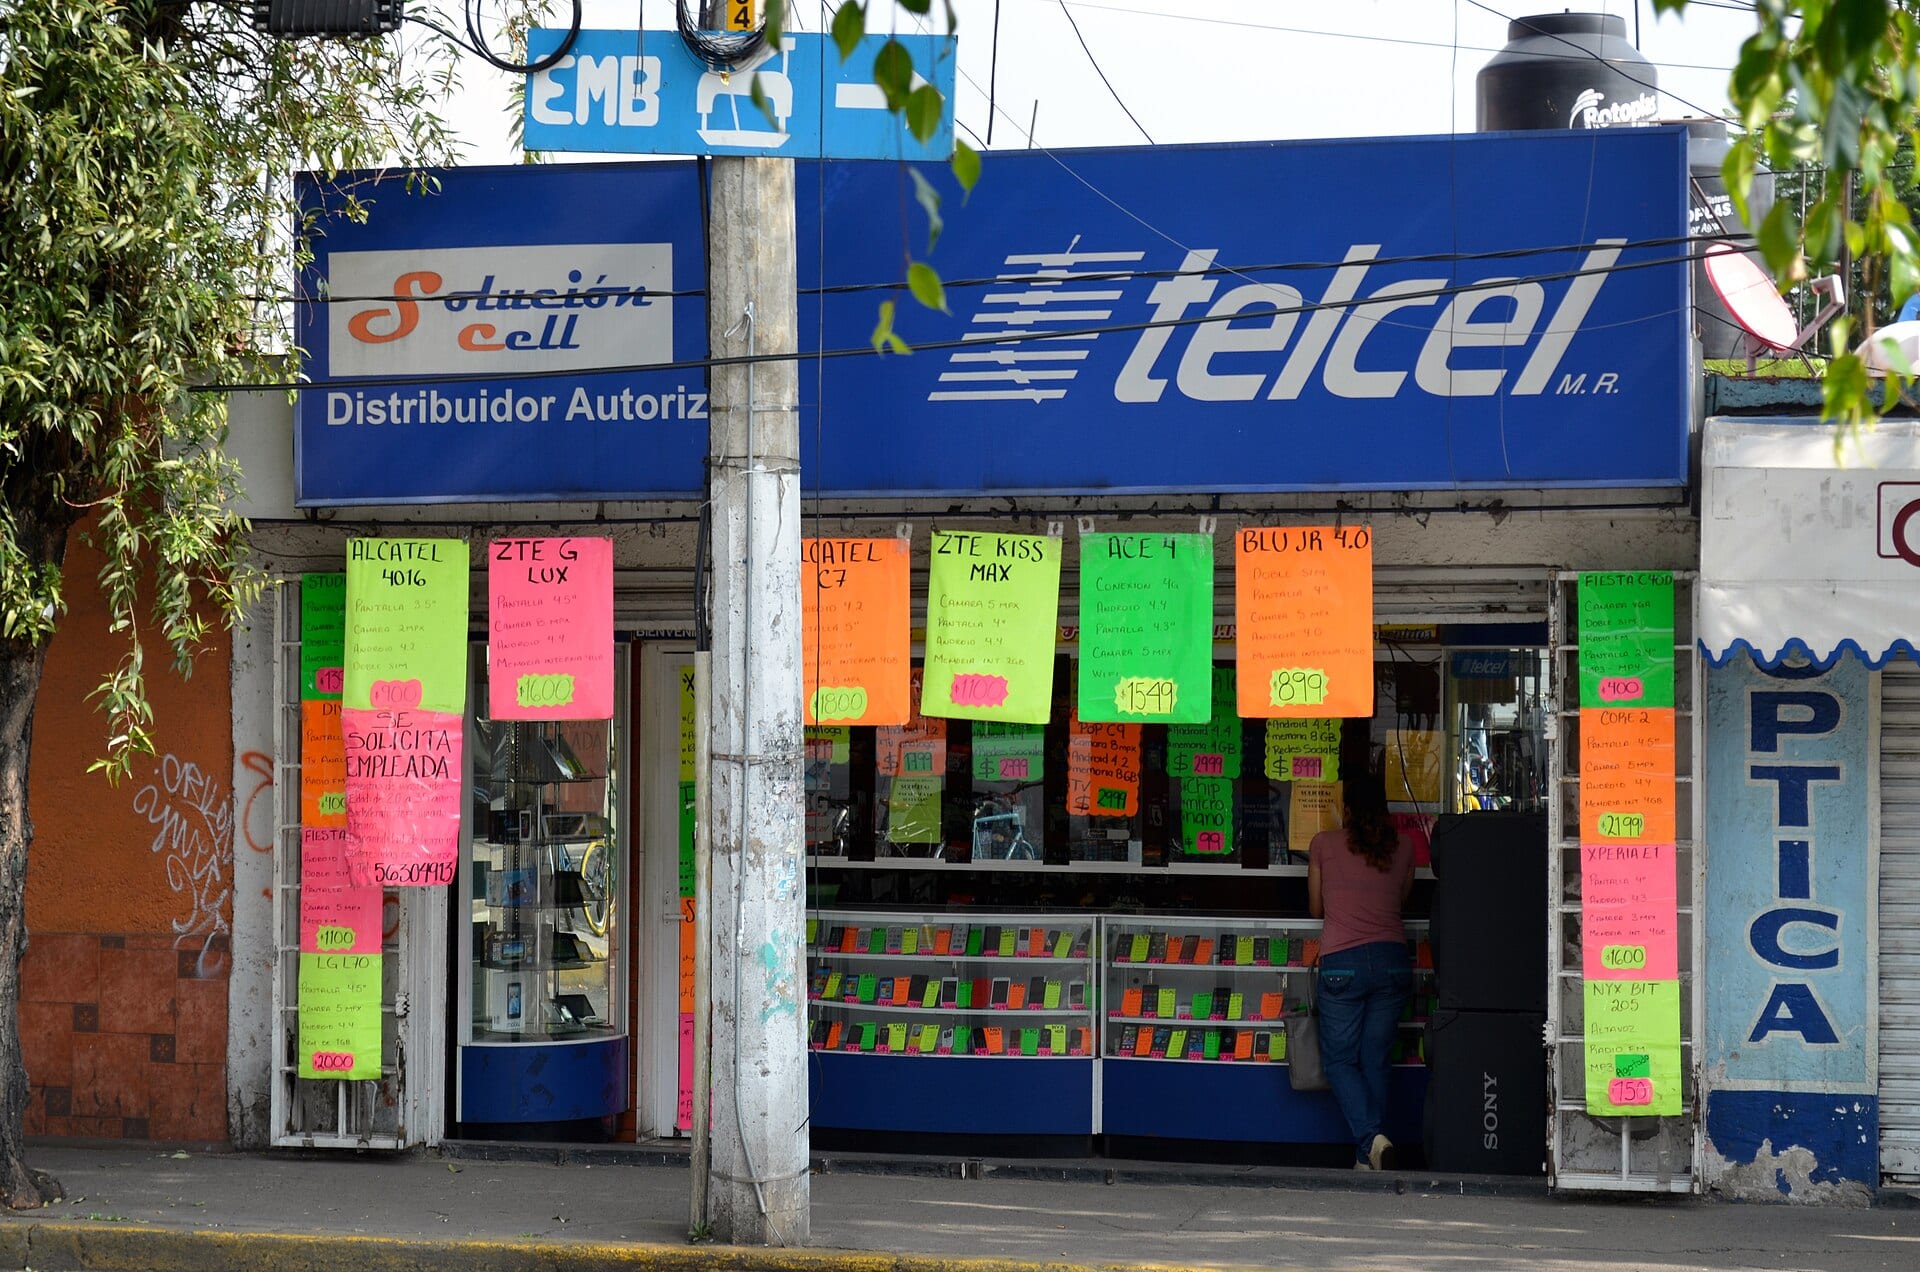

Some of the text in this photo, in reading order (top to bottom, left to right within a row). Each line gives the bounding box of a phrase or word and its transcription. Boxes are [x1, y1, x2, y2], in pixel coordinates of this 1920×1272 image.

[734, 6, 750, 28] 4
[531, 54, 660, 127] EMB
[1113, 238, 1628, 403] telcel
[458, 314, 580, 352] cell
[327, 385, 708, 426] Distribuidor Autoriz
[936, 534, 1043, 563] ZTE KISS
[1108, 536, 1176, 560] ACE 4
[1243, 530, 1369, 553] BLU JR 4.0
[352, 540, 443, 562] ALCATEL
[494, 539, 578, 562] ZTE G
[801, 541, 882, 565] LCATEL
[382, 569, 426, 587] 4016
[528, 566, 569, 584] LUX
[818, 569, 847, 589] C7
[970, 563, 1012, 583] MAX
[1585, 575, 1633, 587] FIESTA
[1096, 577, 1151, 592] CONEXION
[497, 595, 543, 609] PANTALLA
[939, 594, 983, 608] CAMARA
[1096, 601, 1141, 613] ANDROID
[937, 618, 984, 629] PANTALLA
[1096, 624, 1144, 635] PANTALLA
[936, 636, 976, 646] ANDROID
[1092, 647, 1133, 659] CAMARA
[1471, 658, 1508, 674] telcel
[1121, 681, 1173, 713] $1549
[372, 712, 413, 728] SE
[1272, 719, 1308, 729] Android
[1600, 711, 1651, 725] CORE 2
[346, 730, 452, 753] SOLICITA
[1587, 736, 1629, 750] PANTALLA
[346, 755, 449, 779] EMPLEADA
[1174, 753, 1188, 773] $
[1272, 756, 1289, 777] $
[1585, 761, 1620, 772] CAMARA
[1072, 779, 1091, 792] TV
[1586, 782, 1626, 790] ANDROID
[1198, 832, 1221, 850] 99
[1749, 655, 1842, 1044] PTICA
[1588, 847, 1639, 861] XPERIA
[375, 862, 453, 883] 56304913
[1589, 873, 1629, 885] PANTALLA
[317, 956, 369, 970] LG L70
[1593, 983, 1660, 996] NYX BIT
[1611, 999, 1639, 1012] 205
[1591, 1022, 1637, 1034] ALTAVOZ
[1590, 1045, 1623, 1054] RADIO
[1484, 1071, 1498, 1150] SONY
